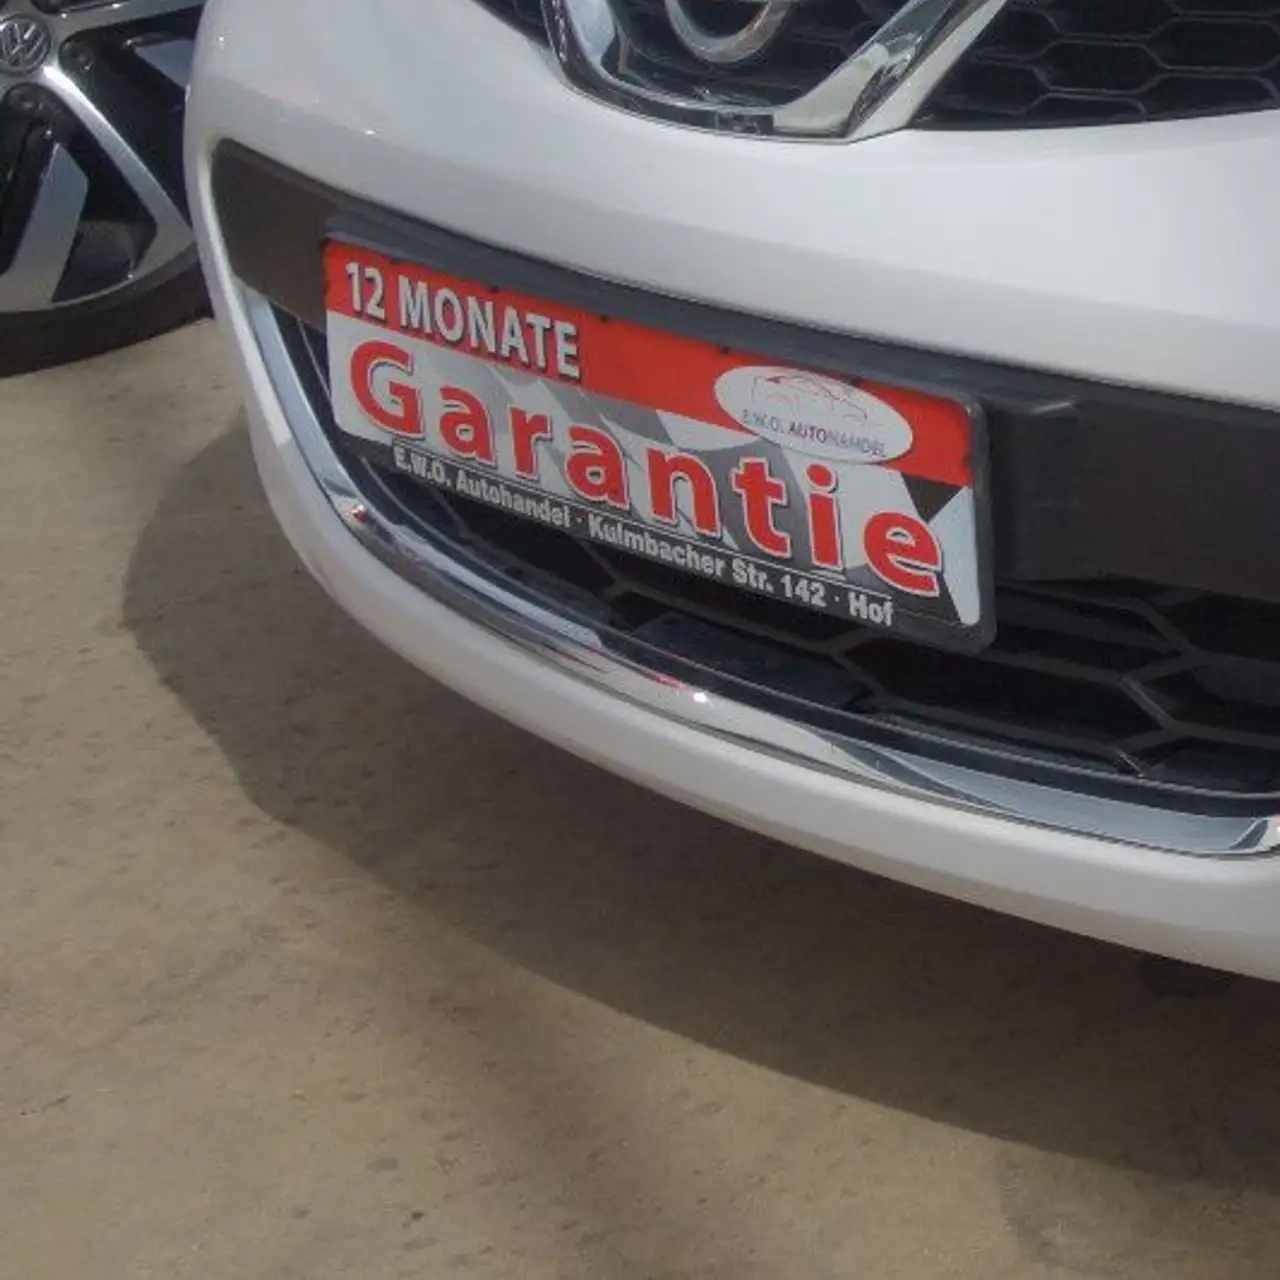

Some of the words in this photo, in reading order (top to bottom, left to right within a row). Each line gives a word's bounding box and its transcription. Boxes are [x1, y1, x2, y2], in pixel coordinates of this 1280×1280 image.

[345, 261, 386, 321] 12
[398, 274, 581, 379] MONATE
[349, 339, 944, 598] Garantie
[393, 444, 451, 488] E.W.O.
[455, 468, 572, 528] Autohandel
[588, 513, 725, 578] Kulmbacher
[731, 558, 774, 593] Str.
[780, 573, 827, 608] 142
[848, 590, 894, 627] Hof
